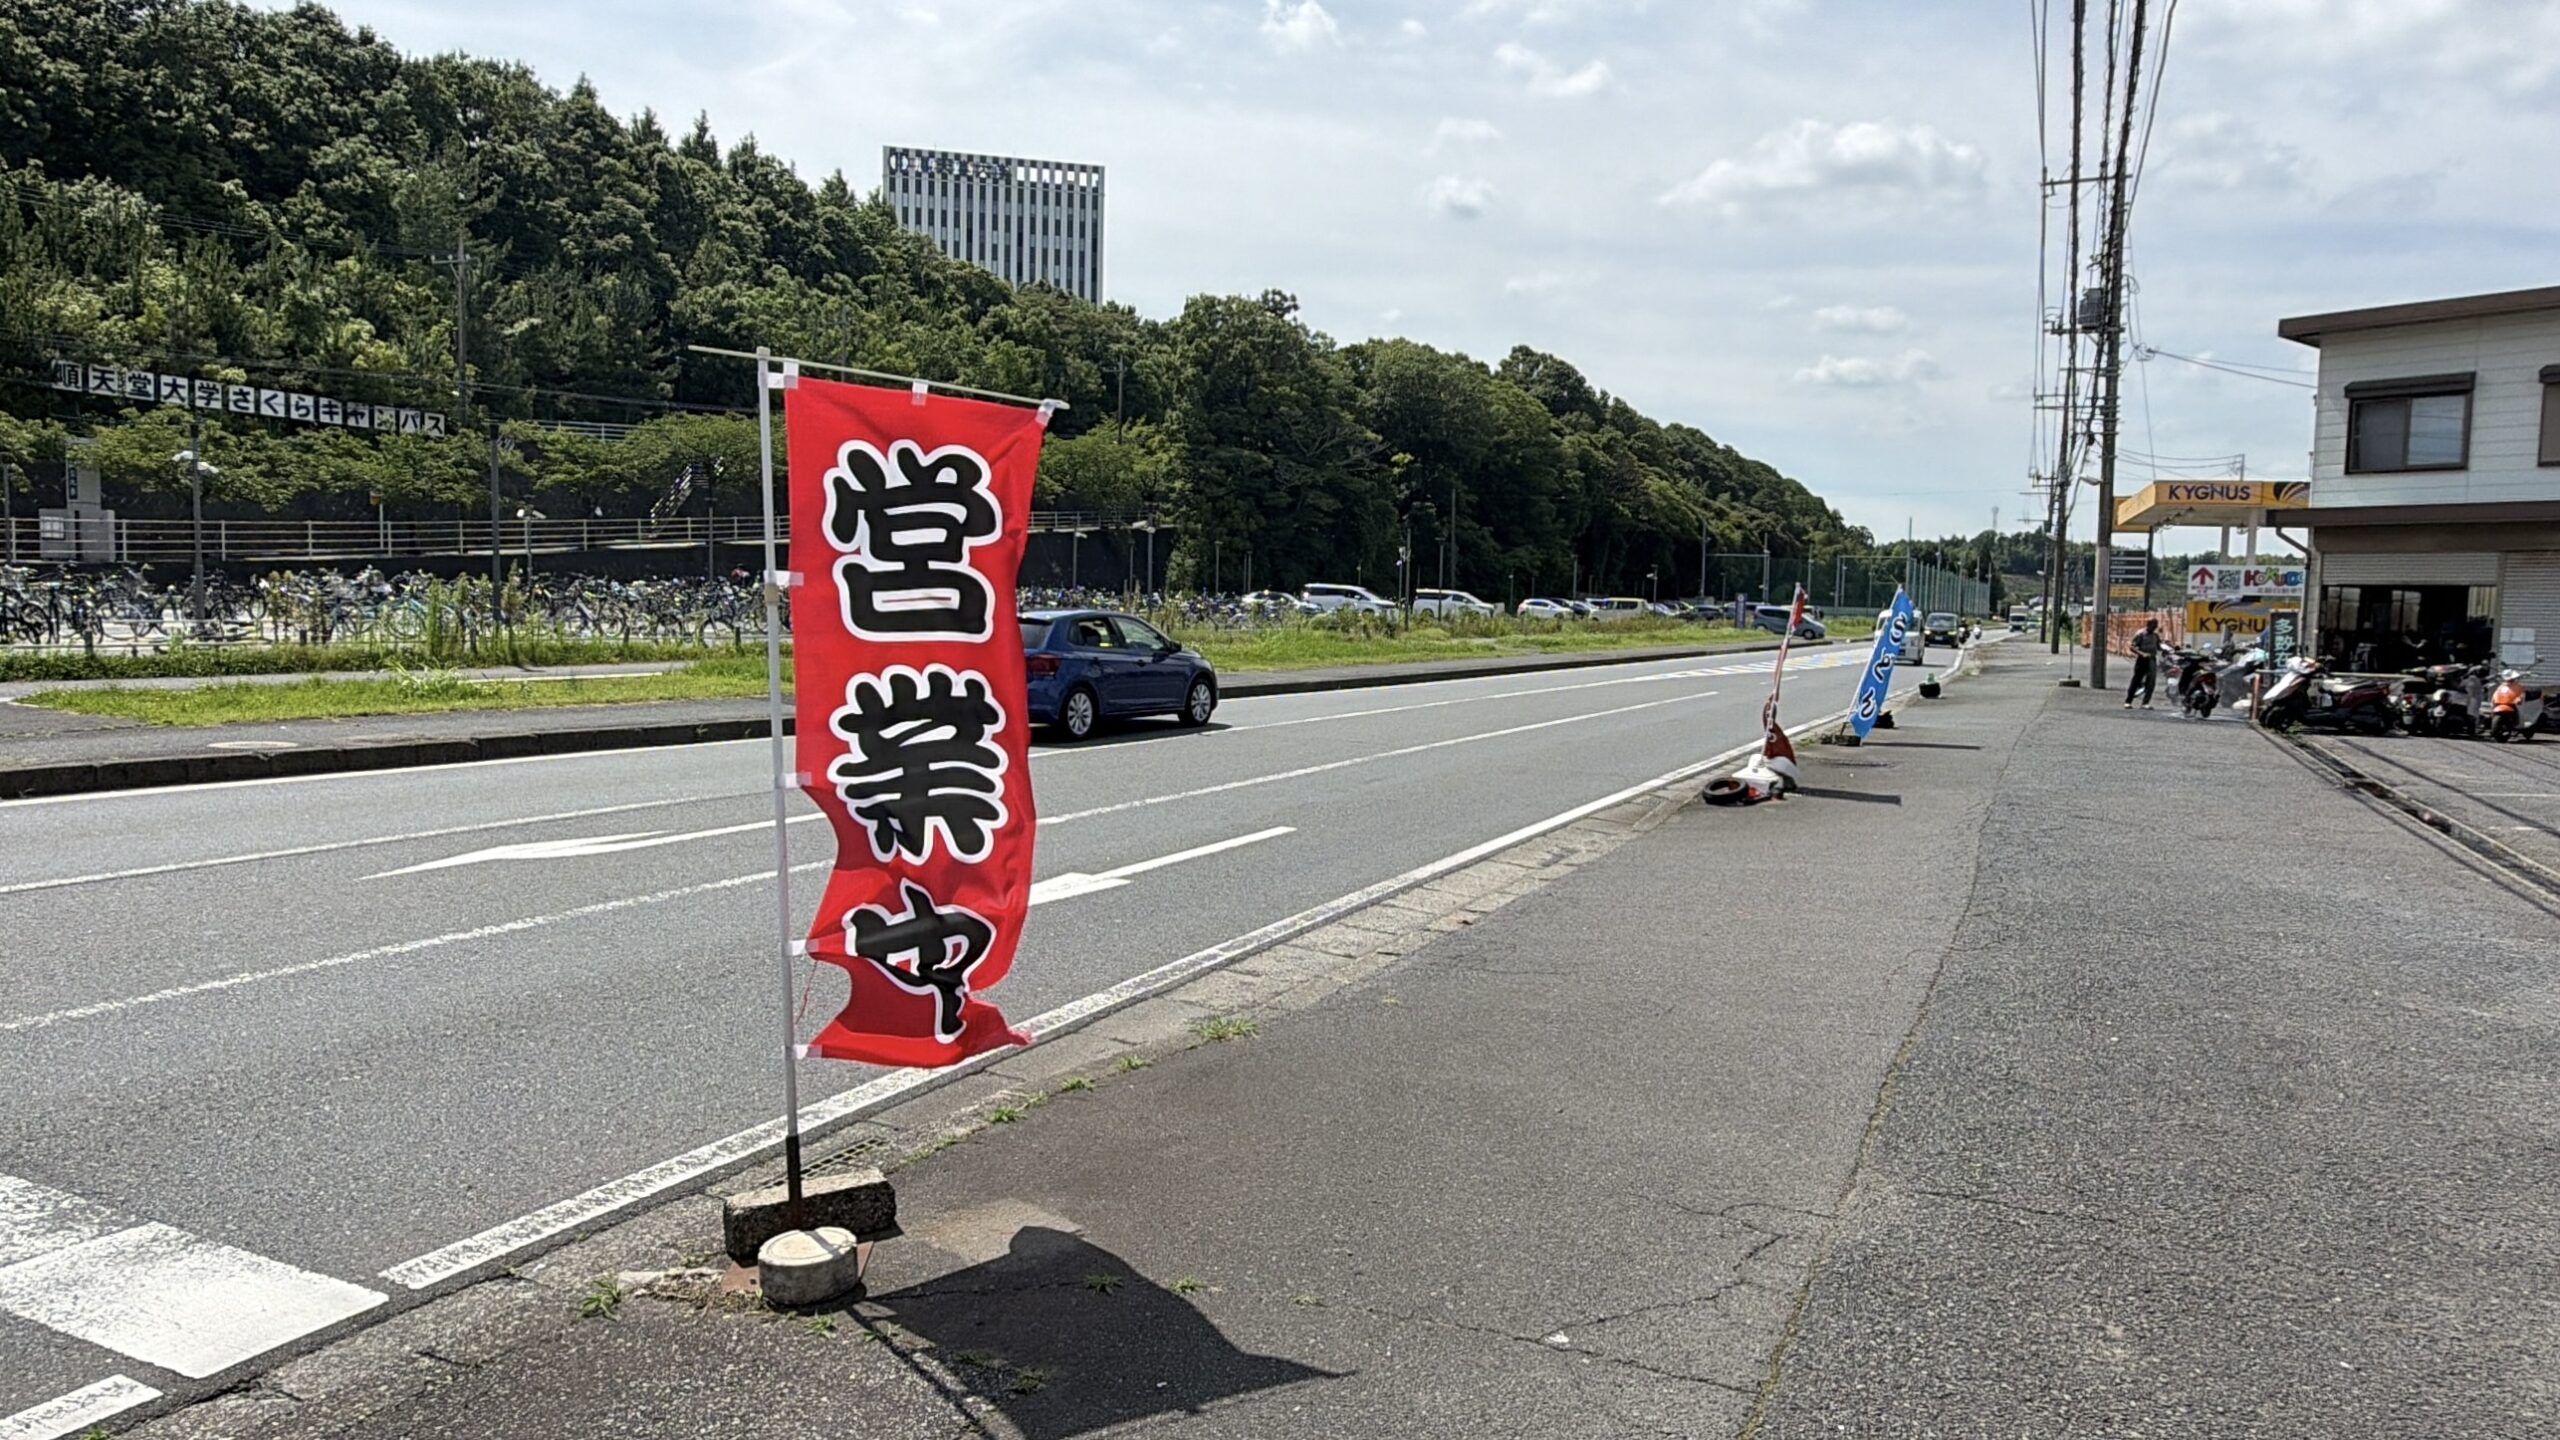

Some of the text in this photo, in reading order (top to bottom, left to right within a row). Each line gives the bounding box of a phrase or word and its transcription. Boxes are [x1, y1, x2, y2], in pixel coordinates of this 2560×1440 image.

[54, 363, 445, 436] 順天堂大学さくらキャンパス
[2168, 484, 2251, 500] KYGNUS
[826, 438, 1009, 1044] 営業中
